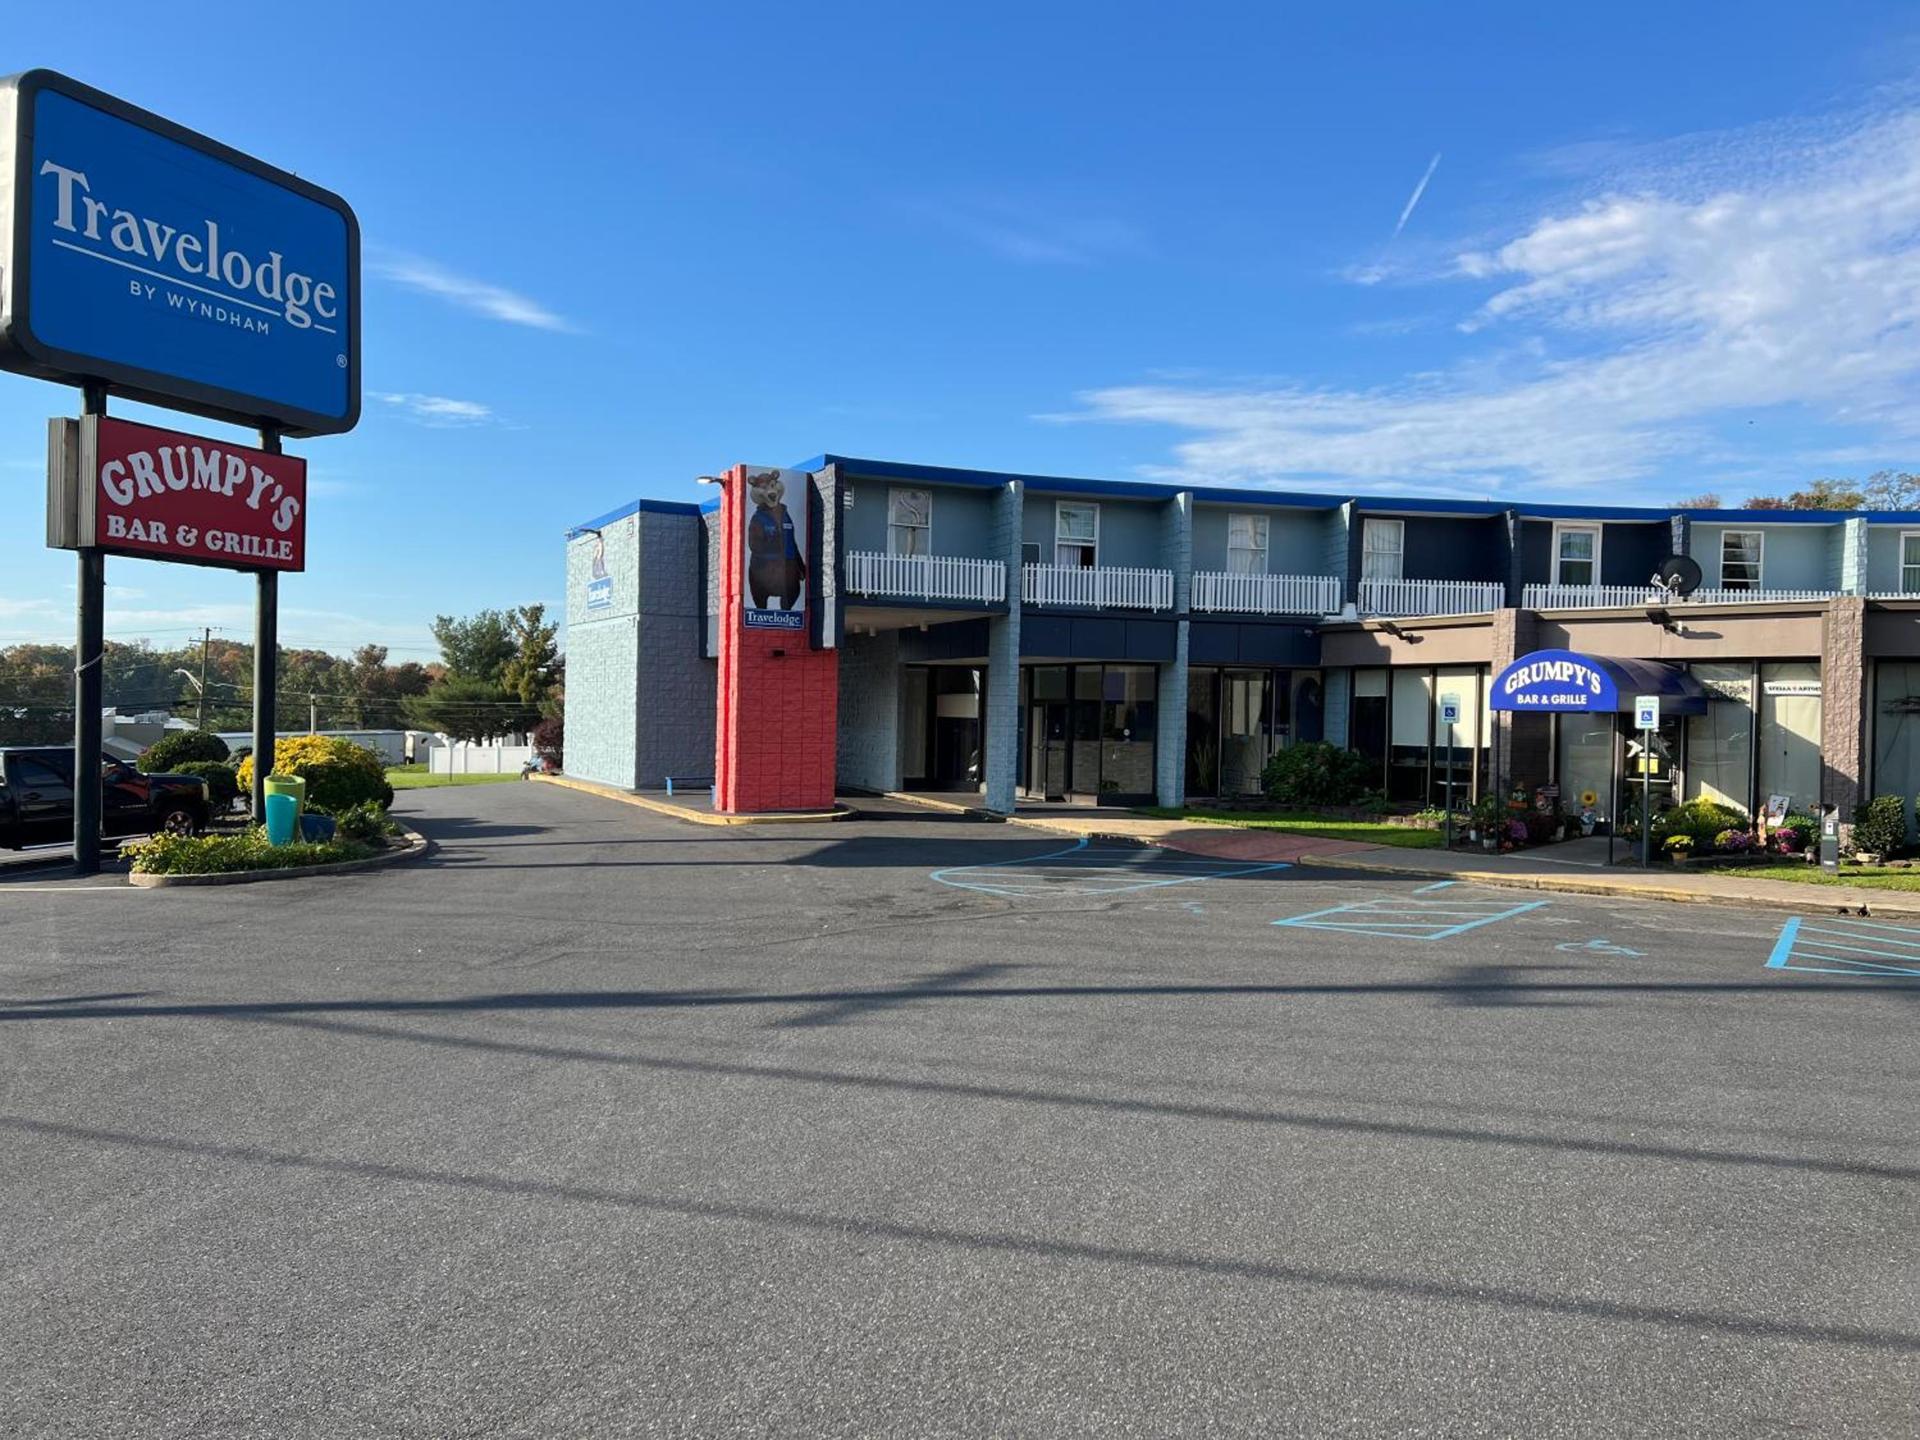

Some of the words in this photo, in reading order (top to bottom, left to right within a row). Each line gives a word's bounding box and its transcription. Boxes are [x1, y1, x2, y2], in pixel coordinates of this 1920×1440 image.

[39, 159, 337, 329] Travelodge
[130, 280, 156, 300] BY
[167, 291, 269, 335] WYNDHAM
[101, 445, 300, 532] GRUMPY'S
[106, 514, 168, 544] BAR
[176, 525, 198, 547] &
[204, 530, 294, 561] GRILLE
[746, 610, 801, 626] Travelodge
[1504, 660, 1602, 695] GRUMPY'S
[1517, 694, 1539, 705] BAR
[1541, 694, 1549, 705] &
[1551, 694, 1588, 705] GRILLE
